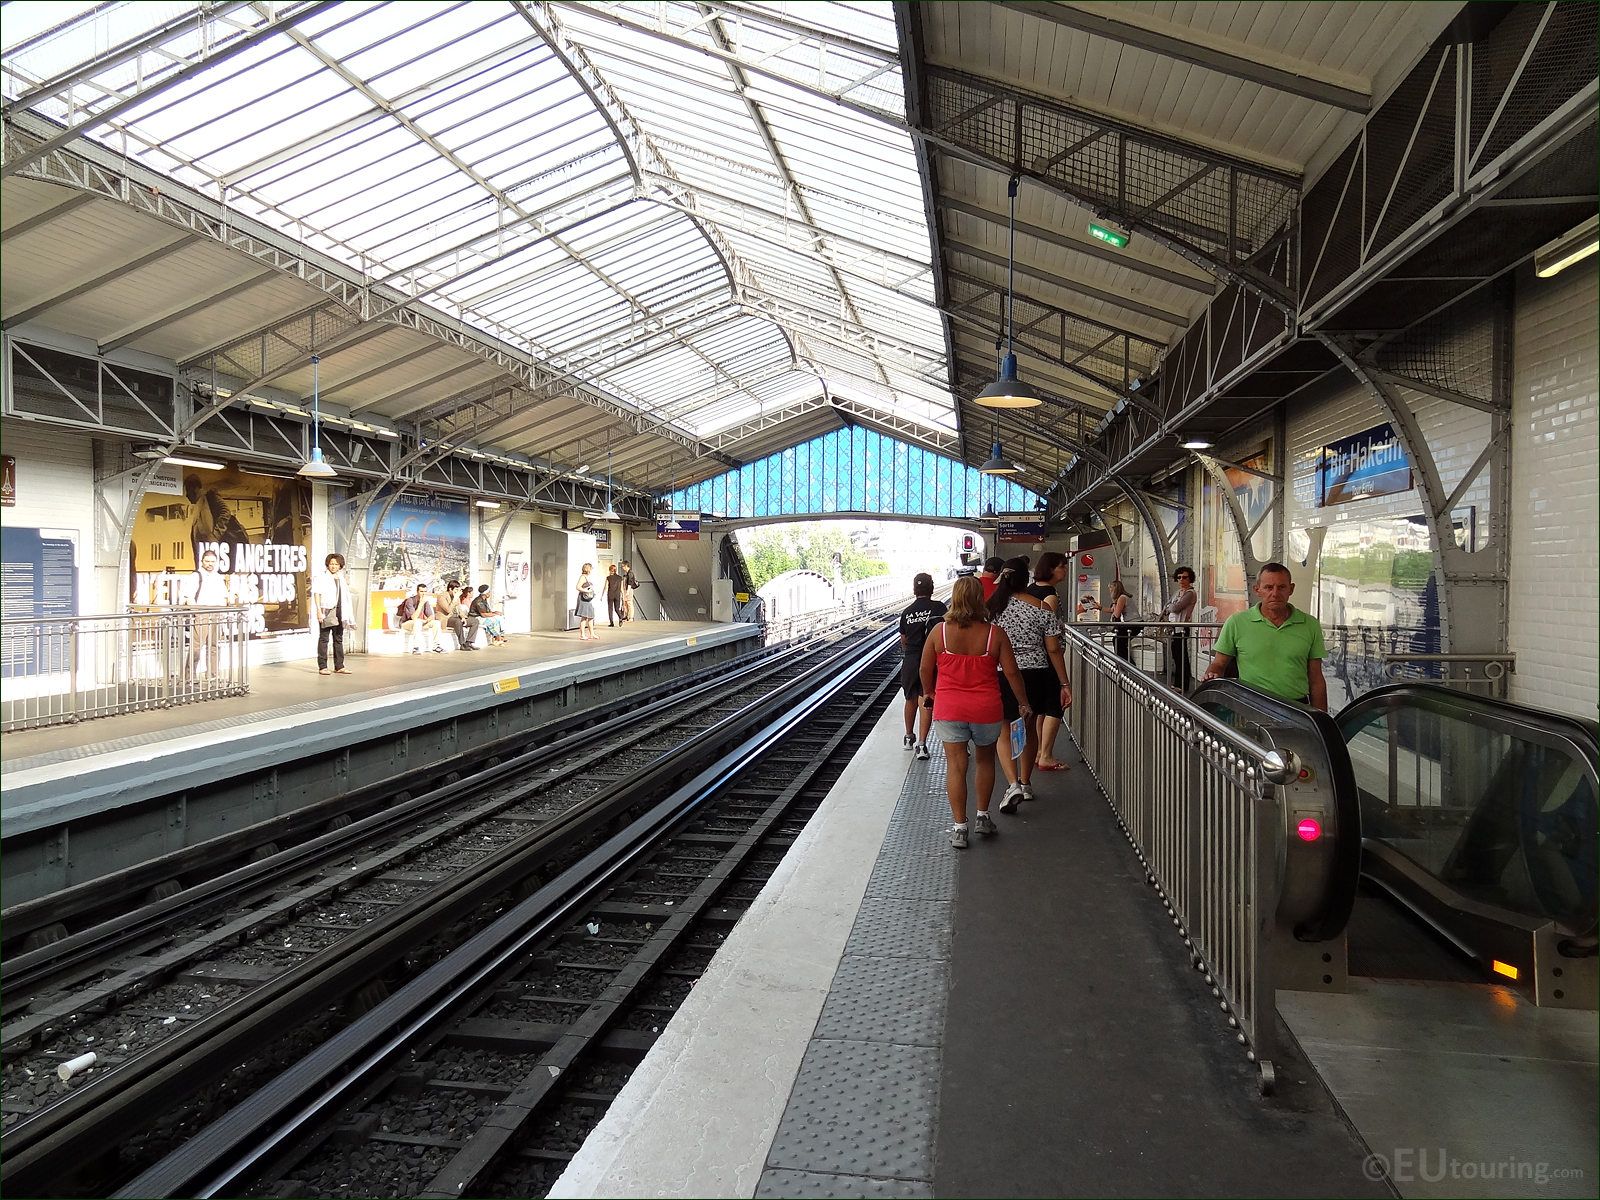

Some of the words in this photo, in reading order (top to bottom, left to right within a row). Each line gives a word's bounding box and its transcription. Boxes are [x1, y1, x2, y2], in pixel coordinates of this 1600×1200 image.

[1330, 429, 1402, 478] Bir-Hakeim
[234, 538, 307, 573] ANCÊTRES
[263, 573, 296, 602] TOUS
